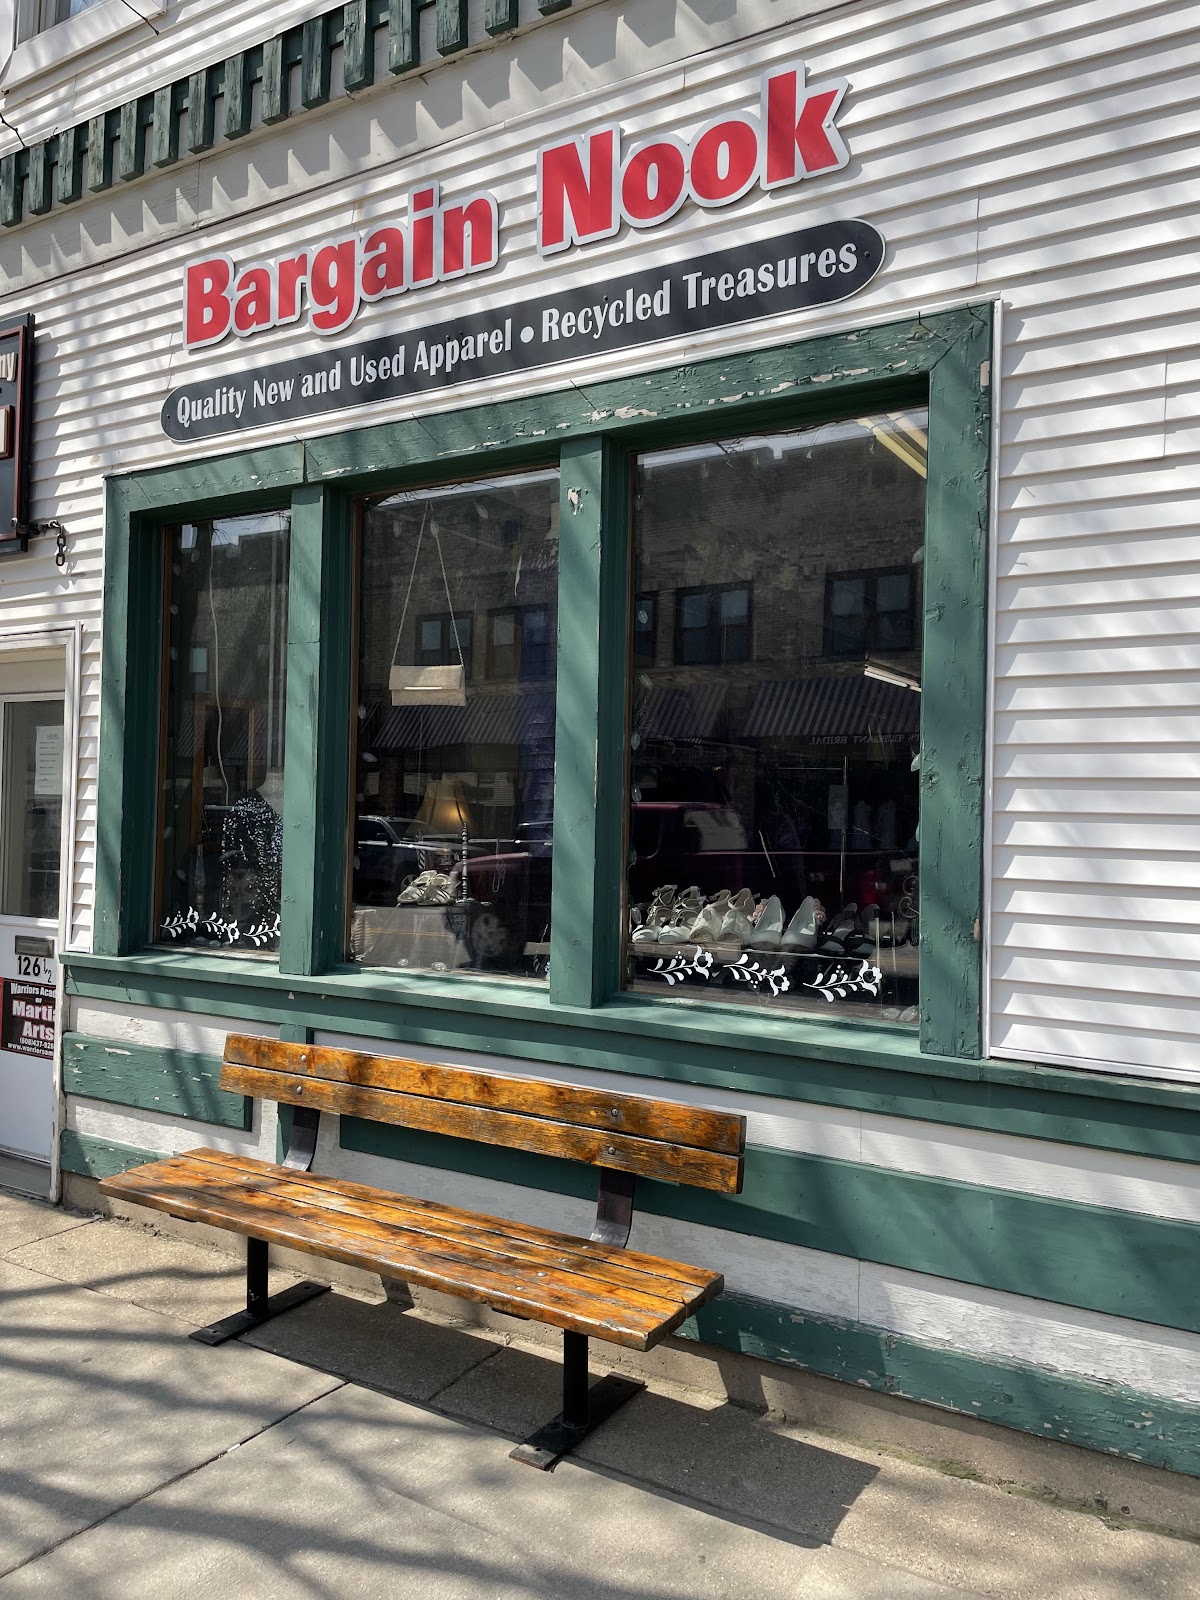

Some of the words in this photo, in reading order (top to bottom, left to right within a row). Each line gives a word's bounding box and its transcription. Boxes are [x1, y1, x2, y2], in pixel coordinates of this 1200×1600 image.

[185, 185, 495, 347] Bargain
[540, 67, 843, 250] Nook
[541, 280, 671, 339] Recycled
[683, 242, 857, 309] Treasures
[177, 386, 246, 427] Quality
[253, 377, 295, 408] New
[301, 361, 341, 396] and
[350, 345, 404, 386] Used
[414, 318, 511, 376] Apparel
[18, 955, 40, 977] 126
[10, 982, 39, 995] Warriors
[12, 1000, 56, 1022] Marti
[22, 1021, 54, 1041] Arts
